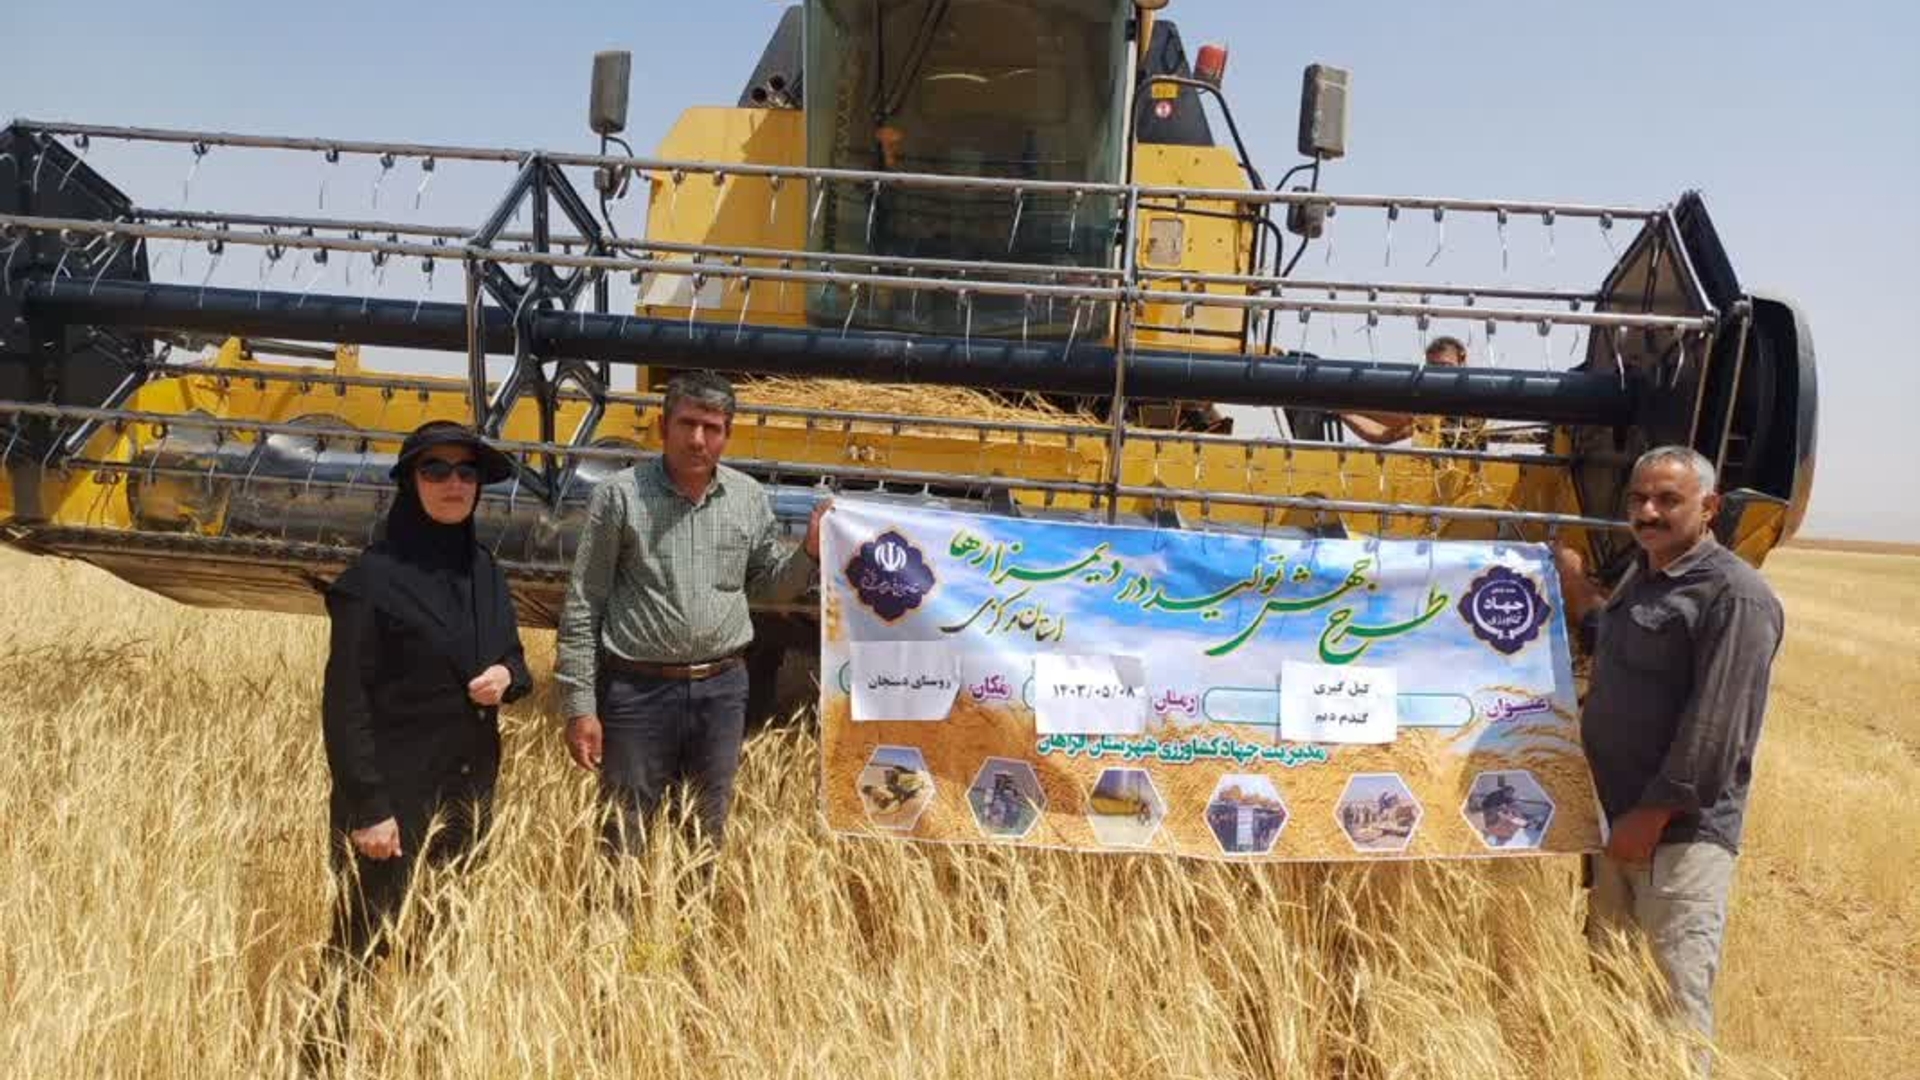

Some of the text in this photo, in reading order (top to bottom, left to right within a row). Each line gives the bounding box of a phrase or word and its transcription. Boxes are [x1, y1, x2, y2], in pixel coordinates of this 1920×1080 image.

[1204, 557, 1378, 656] جهش
[1483, 596, 1524, 614] جهاد
[1018, 604, 1065, 642] استان
[1318, 583, 1448, 664] طرح
[1339, 712, 1369, 726] گندم
[1089, 733, 1157, 758] شهرستان
[1158, 736, 1220, 762] کشاورزی
[1219, 738, 1259, 763] جهاد
[1261, 746, 1326, 765] مدیریت
